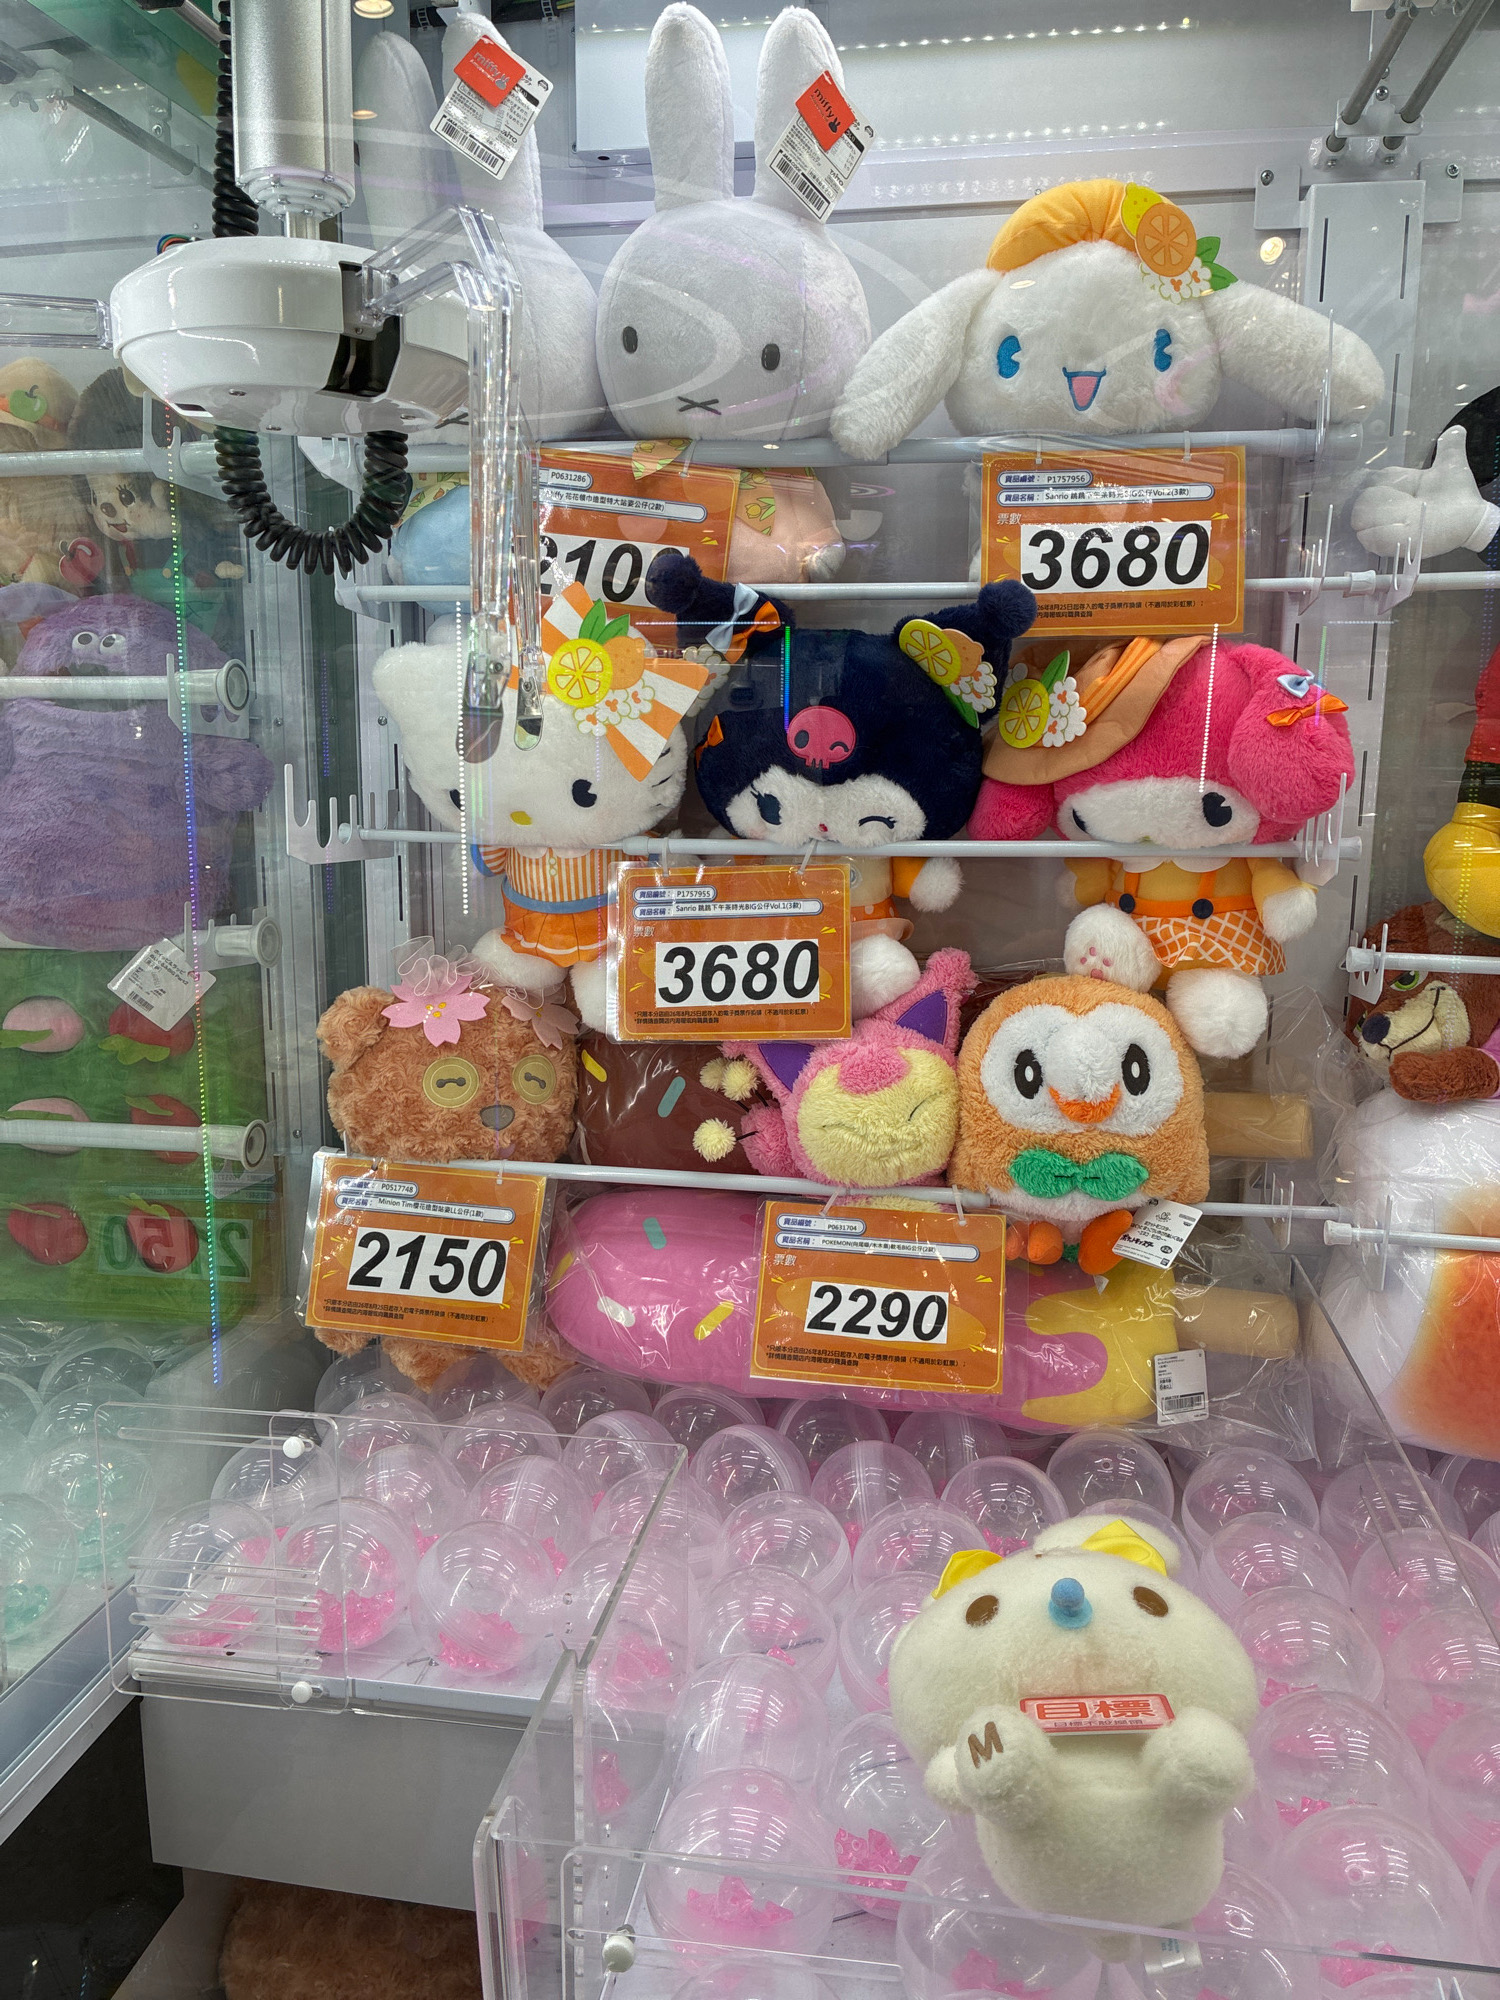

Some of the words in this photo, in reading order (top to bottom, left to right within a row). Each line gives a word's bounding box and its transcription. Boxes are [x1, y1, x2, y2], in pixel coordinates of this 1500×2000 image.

[473, 52, 501, 77] miffy
[814, 88, 834, 118] miffy
[550, 472, 587, 483] P0631286
[1047, 475, 1086, 483] P1757956
[1045, 492, 1069, 500] Sanrio
[996, 513, 1022, 526] 票數
[1021, 523, 1210, 591] 3680
[677, 890, 711, 898] P1757955
[676, 904, 697, 912] Sanrio
[658, 940, 820, 1004] 3680
[381, 1183, 414, 1193] P0517748
[378, 1197, 401, 1208] Minion
[827, 1224, 857, 1232] P0631704
[349, 1231, 507, 1297] 2150
[773, 1254, 797, 1267] 票數
[807, 1284, 948, 1342] 2290
[1036, 1699, 1156, 1720] 目標
[968, 1721, 1004, 1769] M
